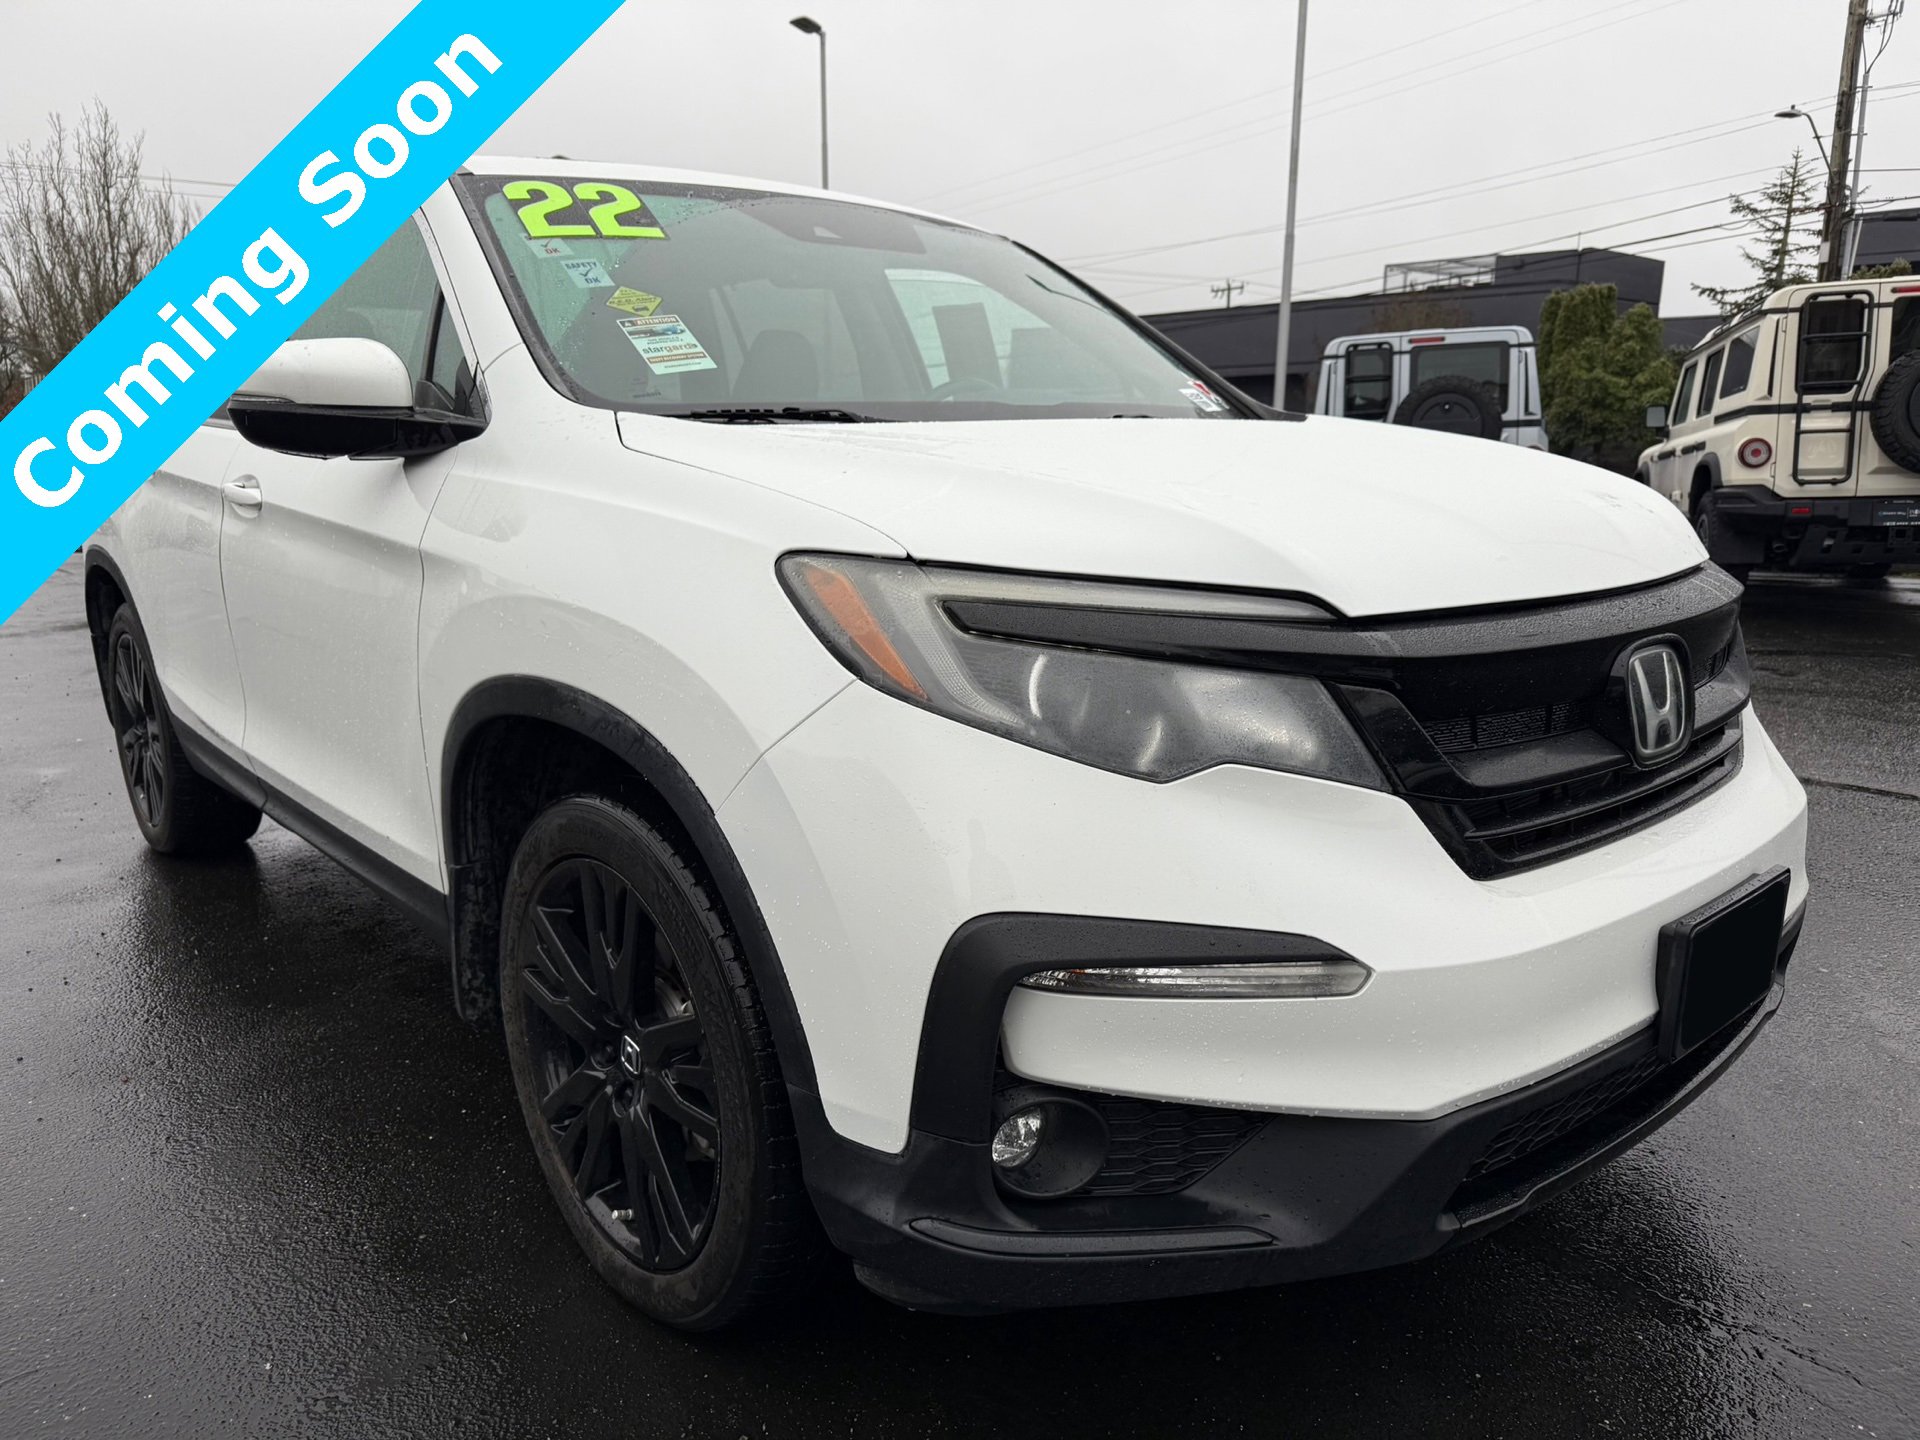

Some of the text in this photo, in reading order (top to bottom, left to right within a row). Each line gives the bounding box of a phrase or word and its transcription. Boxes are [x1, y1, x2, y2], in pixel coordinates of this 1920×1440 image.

[503, 181, 666, 238] 22
[564, 261, 598, 270] SAFETY
[636, 317, 678, 326] ATTENTION
